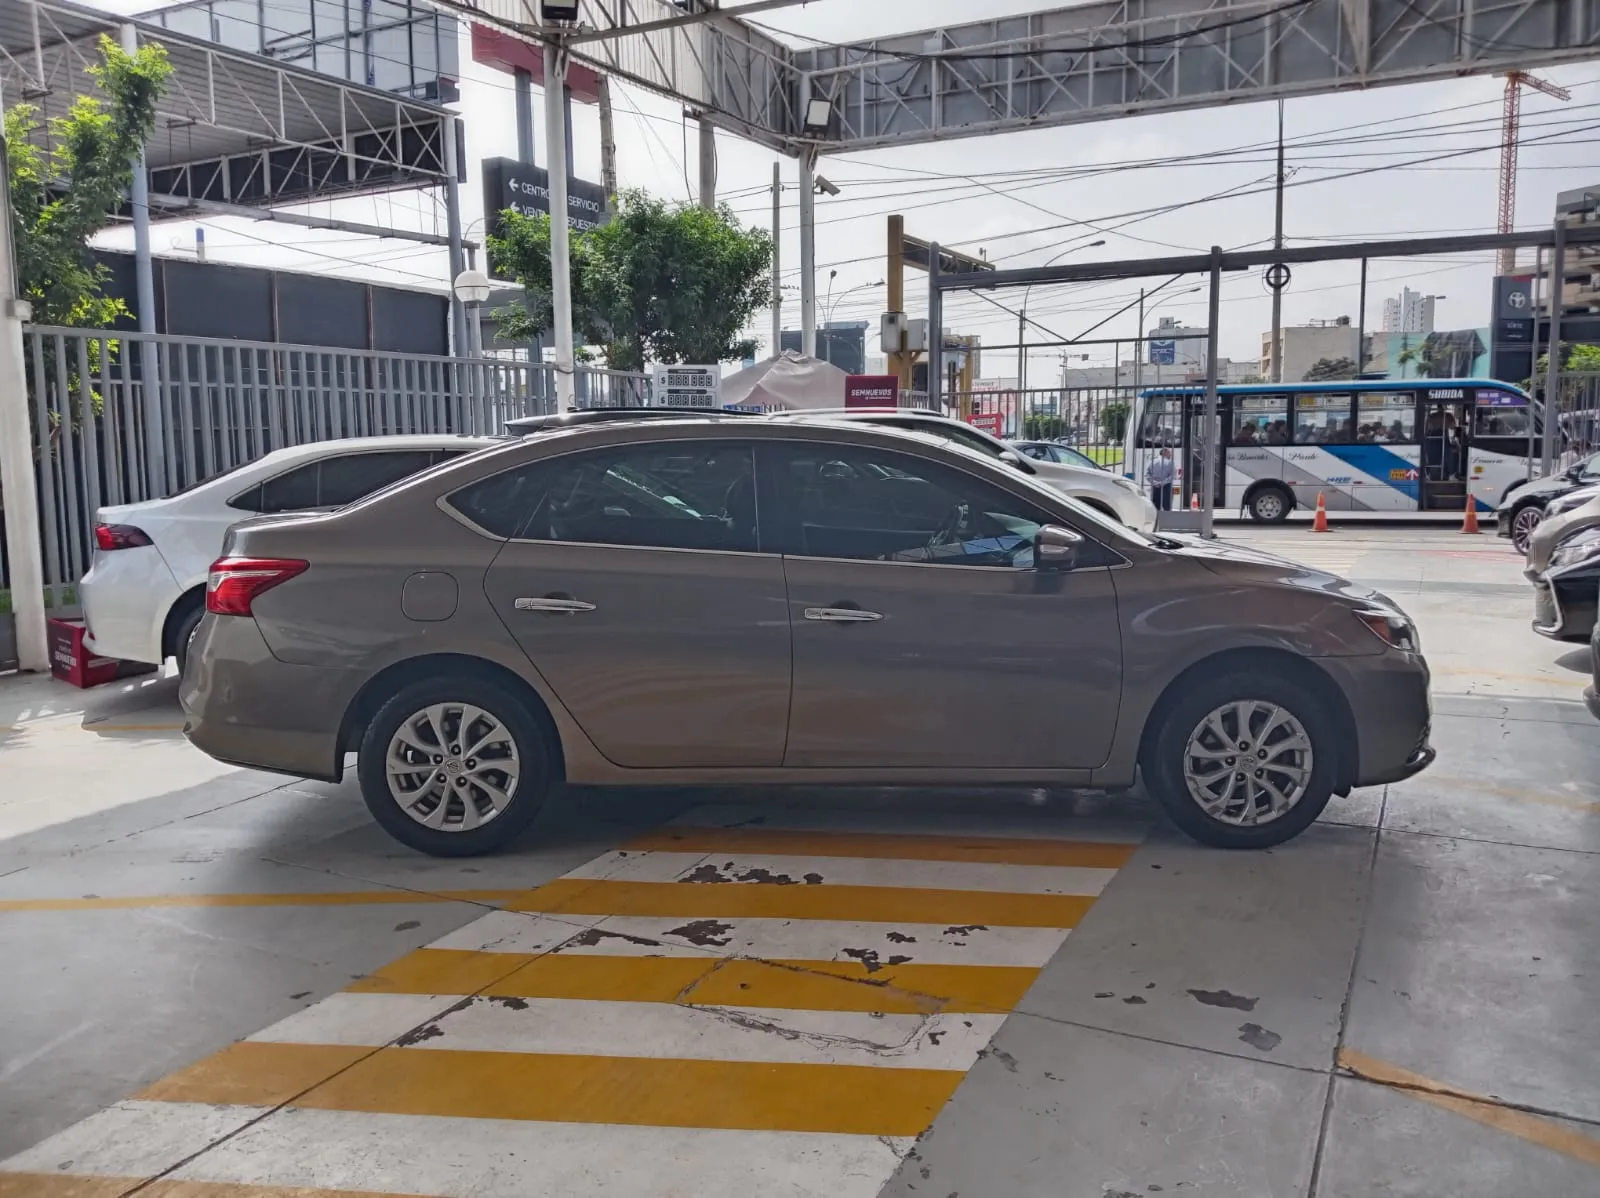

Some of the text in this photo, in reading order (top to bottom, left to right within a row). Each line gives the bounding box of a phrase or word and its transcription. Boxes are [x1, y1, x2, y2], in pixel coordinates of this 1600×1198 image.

[521, 182, 600, 213] CENTRO SERVICIO
[1428, 389, 1464, 399] SUBIDA
